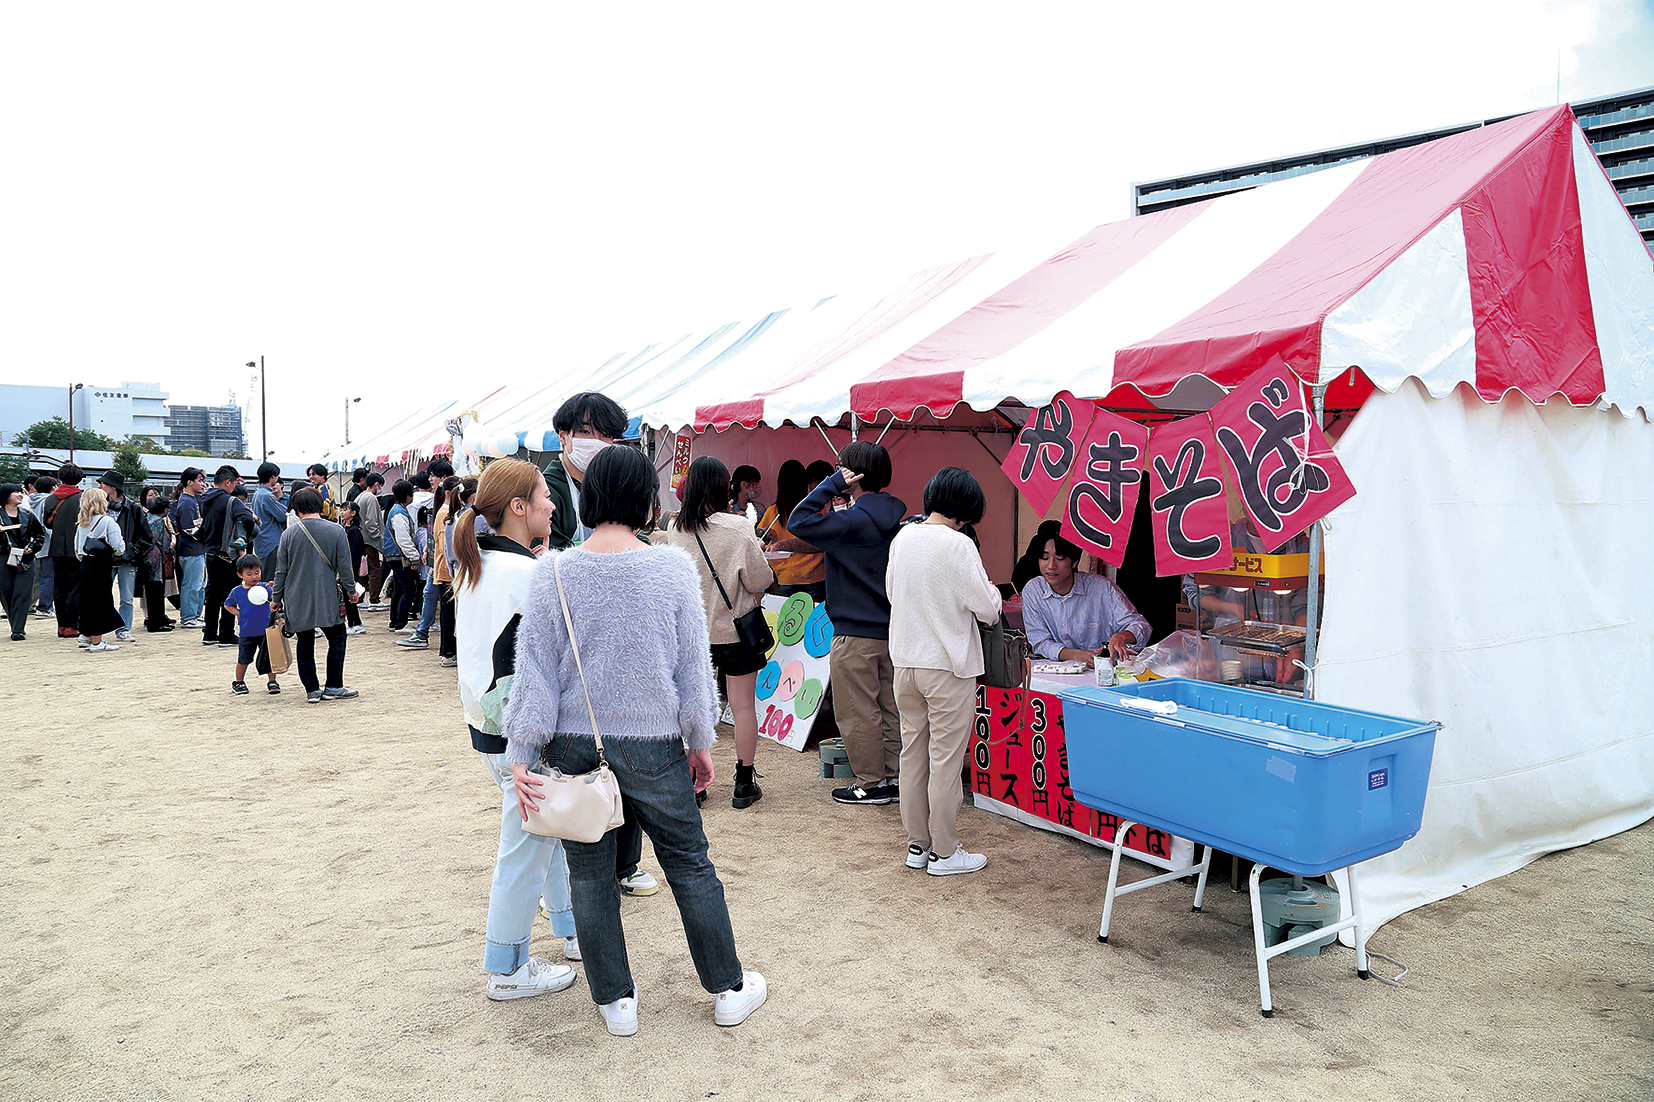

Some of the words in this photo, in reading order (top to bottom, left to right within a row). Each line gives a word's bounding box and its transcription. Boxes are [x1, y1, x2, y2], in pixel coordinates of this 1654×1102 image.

[674, 440, 684, 474] せんべい
[682, 438, 690, 465] ミルク
[1019, 376, 1331, 561] やきそば
[975, 684, 991, 798] 100円
[1000, 691, 1022, 805] ジュース
[1031, 697, 1049, 816] 300円
